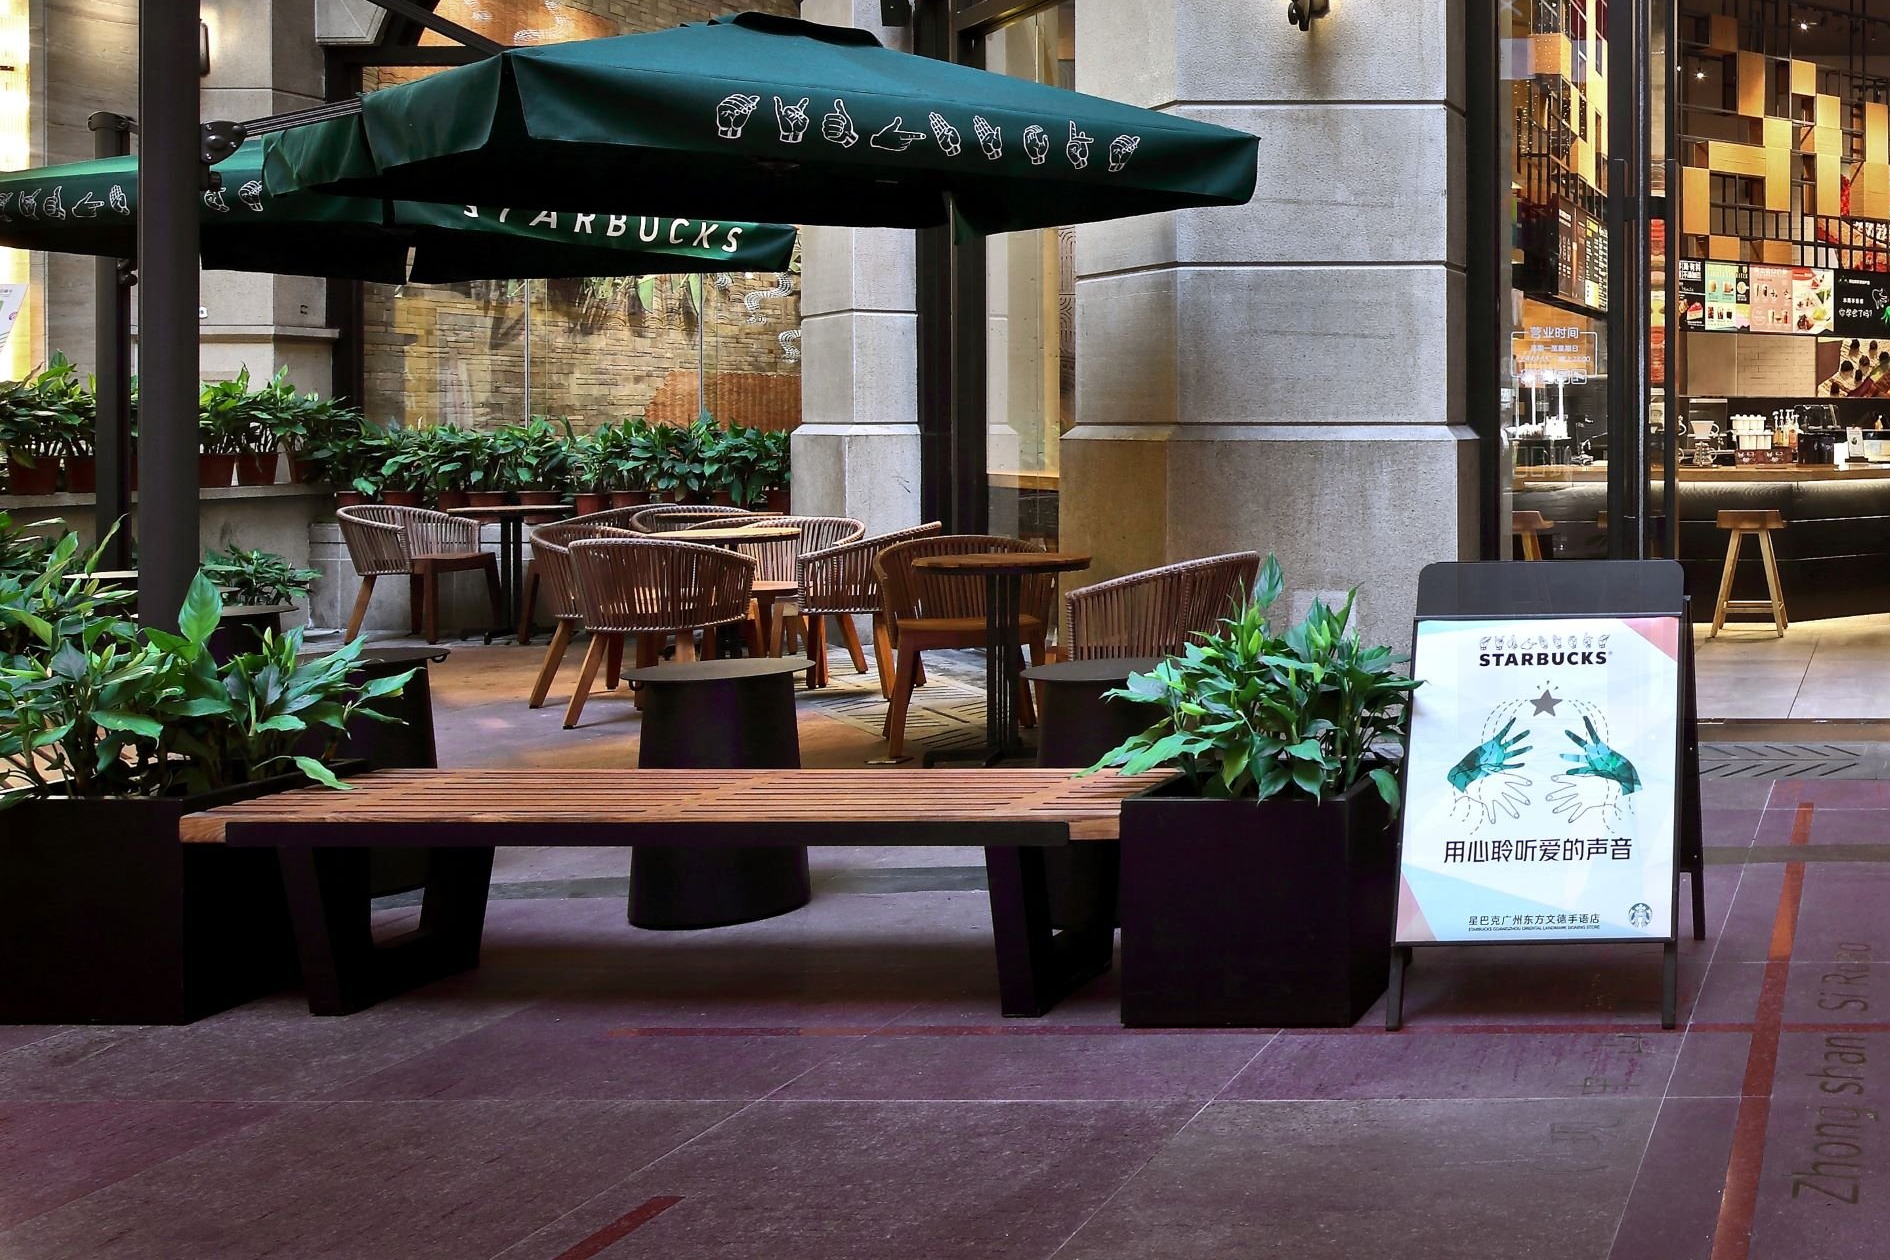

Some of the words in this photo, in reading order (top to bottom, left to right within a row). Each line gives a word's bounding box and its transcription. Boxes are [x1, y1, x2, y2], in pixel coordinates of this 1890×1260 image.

[1529, 326, 1579, 339] 营业时间
[1479, 651, 1607, 667] STARBUCKS
[1443, 837, 1633, 864] 用心聆听爱的声音
[1468, 914, 1600, 926] 星巴克广州东方文德手语店
[1817, 990, 1868, 1012] Si
[1806, 1034, 1867, 1095] shan
[1790, 1106, 1879, 1205] Zhong
